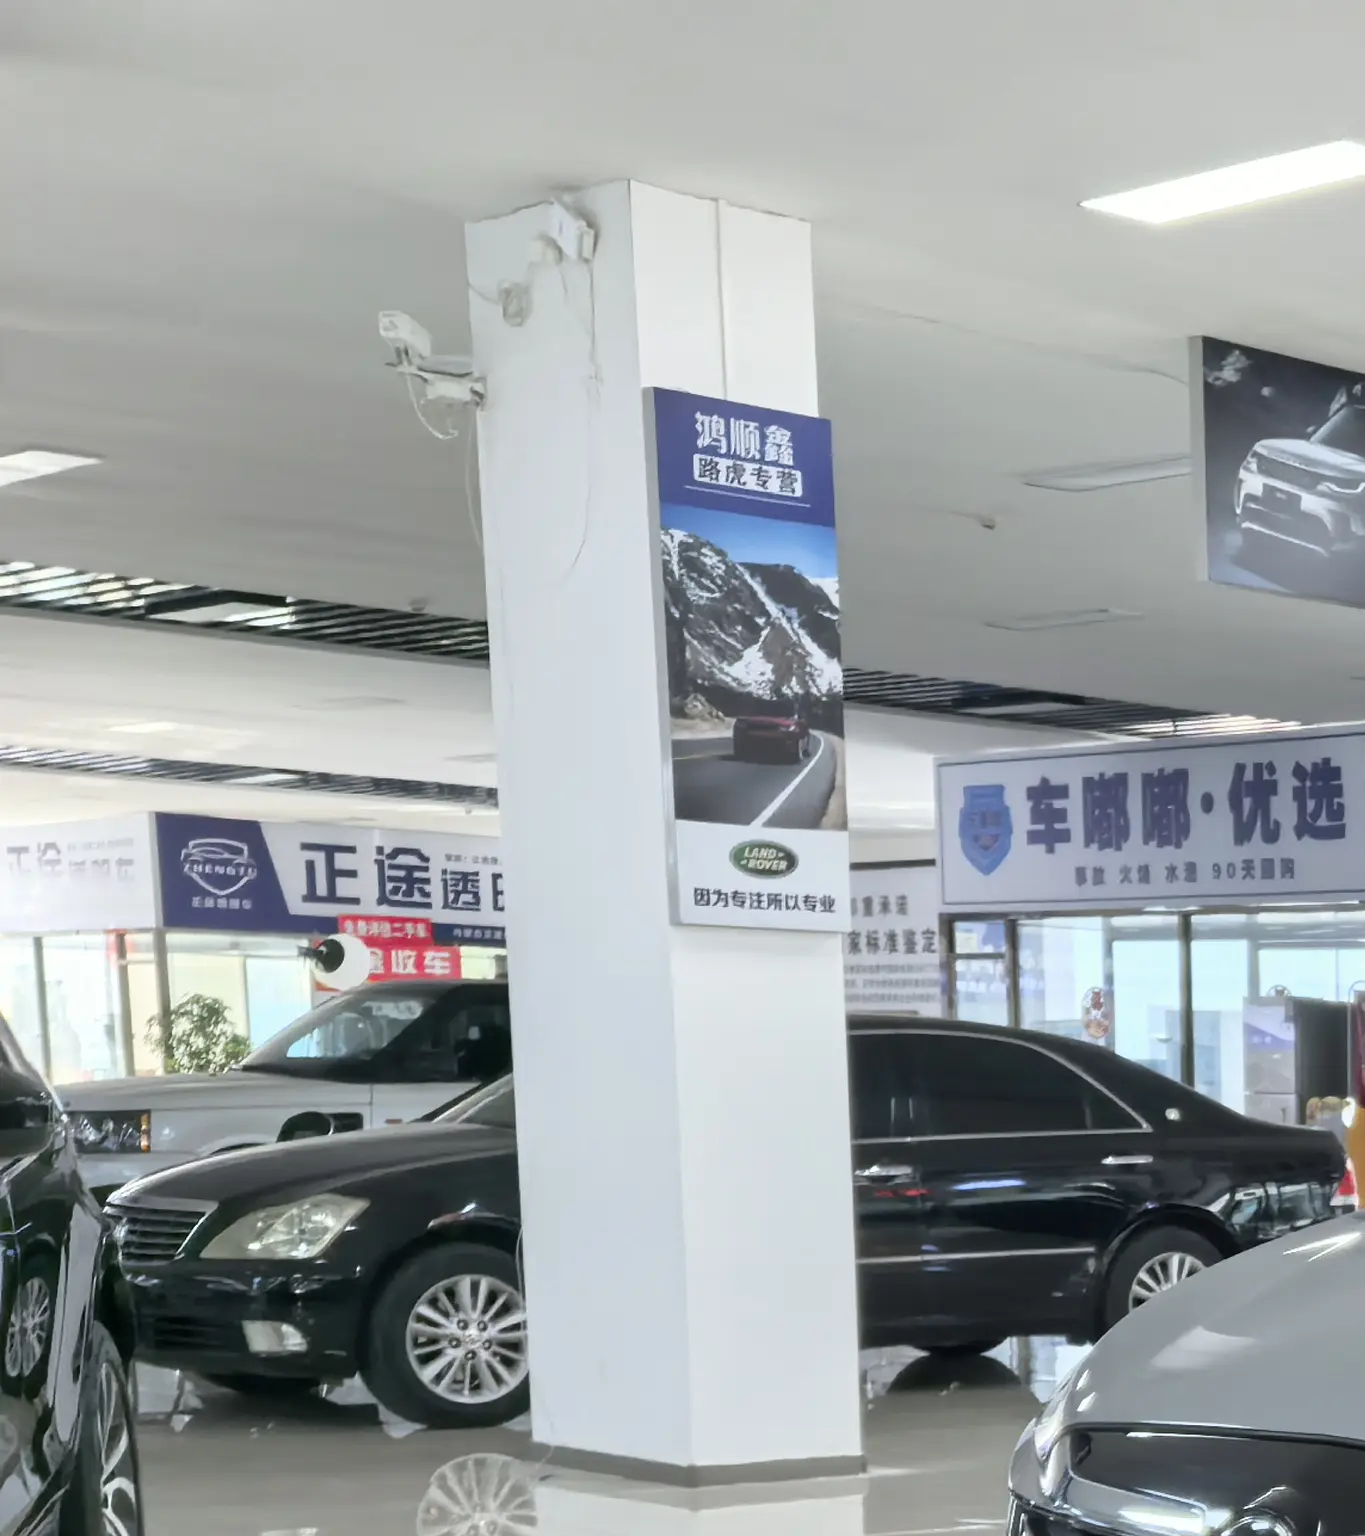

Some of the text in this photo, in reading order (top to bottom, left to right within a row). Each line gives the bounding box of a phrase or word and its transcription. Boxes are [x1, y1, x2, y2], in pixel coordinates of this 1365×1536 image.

[694, 411, 794, 466] 鸿顺鑫
[697, 457, 799, 495] 路虎专营
[1026, 757, 1346, 853] 车嘟嘟·优选
[744, 846, 777, 859] LAND
[747, 859, 788, 871] ROVER
[693, 887, 836, 914] 因为专注所以专业
